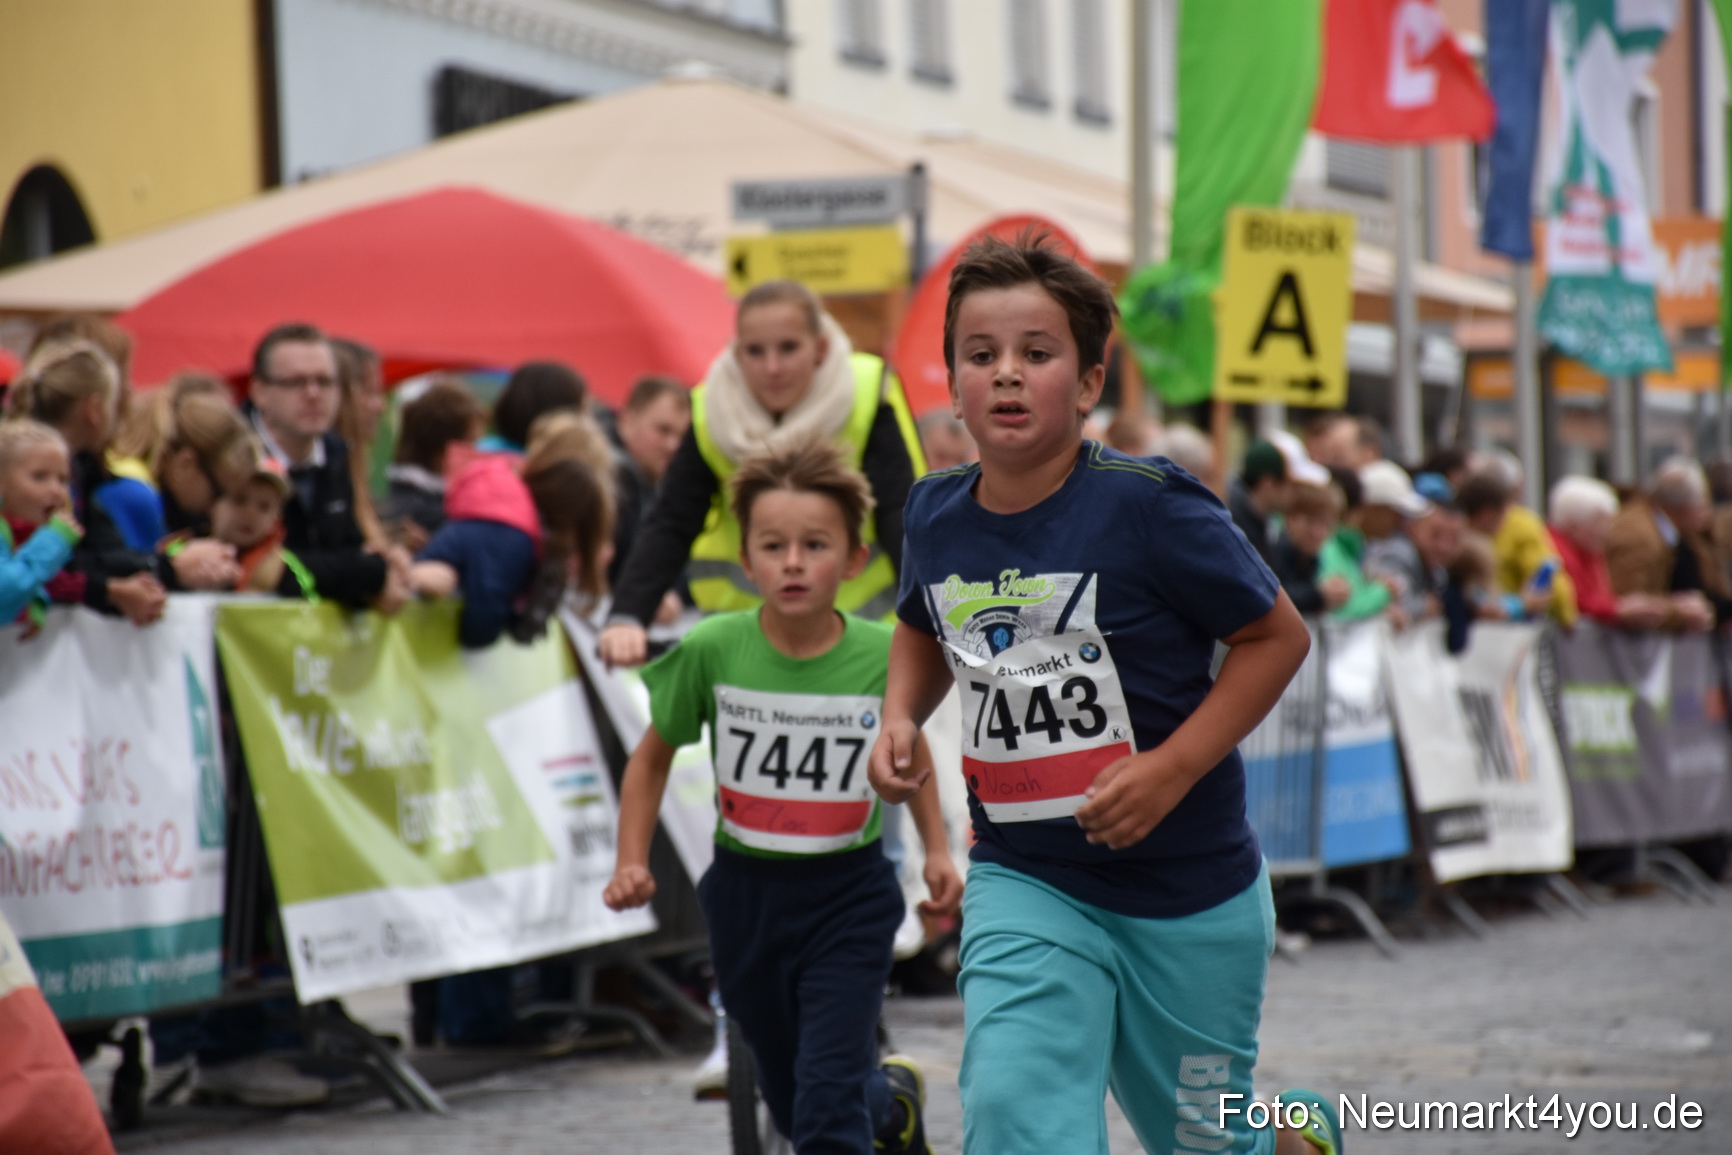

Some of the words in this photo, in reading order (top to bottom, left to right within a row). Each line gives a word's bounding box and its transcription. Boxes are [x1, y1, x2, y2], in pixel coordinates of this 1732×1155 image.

[1244, 215, 1341, 254] Block
[1250, 270, 1316, 357] A
[943, 574, 995, 600] Down
[999, 568, 1047, 597] Town
[999, 652, 1074, 678] eumarkt
[772, 708, 854, 729] Neumarkt
[970, 675, 1108, 751] 7443
[728, 727, 866, 792] 7447
[983, 767, 1042, 795] Noah
[1173, 1054, 1236, 1155] BRO
